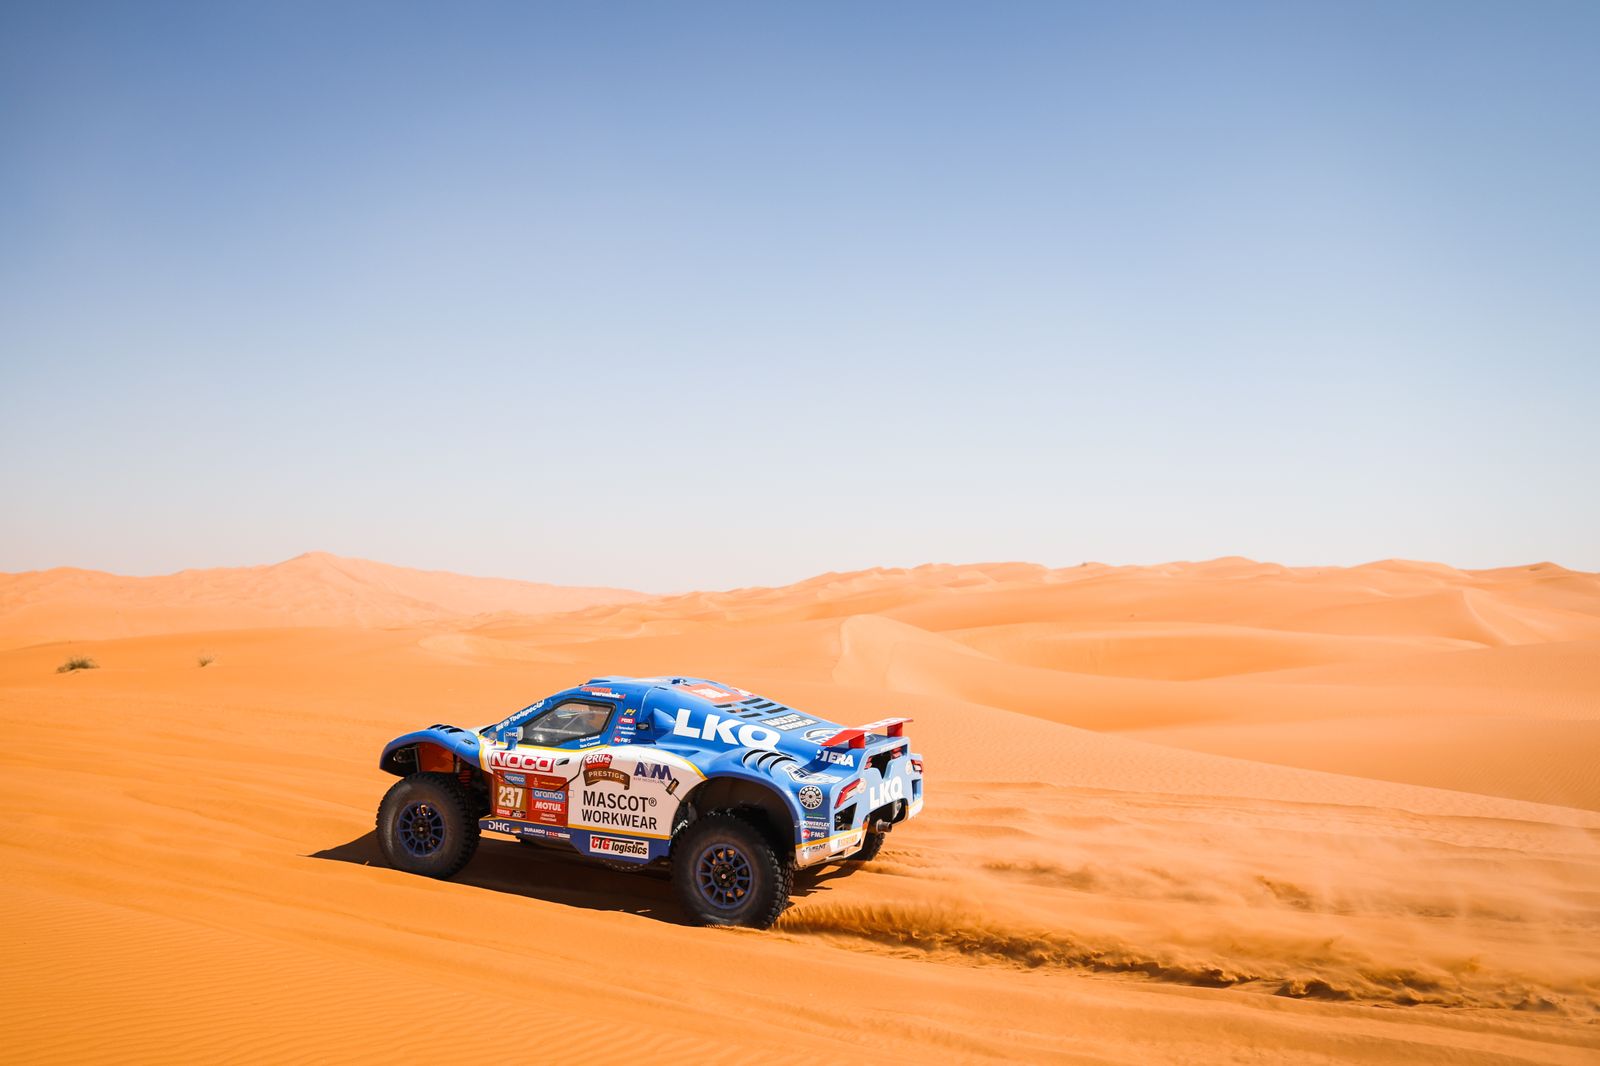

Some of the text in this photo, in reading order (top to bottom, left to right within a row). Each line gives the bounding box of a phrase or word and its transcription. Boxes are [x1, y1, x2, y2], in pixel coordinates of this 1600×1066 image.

[673, 708, 781, 752] LKQ
[588, 770, 625, 781] PRESTIGE
[498, 785, 524, 808] 237
[534, 790, 564, 800] aramco
[869, 776, 903, 810] LKQ
[535, 801, 562, 812] MOTUL
[582, 808, 657, 830] WORKWEAR
[488, 820, 510, 833] DHG
[811, 830, 825, 838] FMS
[611, 841, 648, 855] logistics
